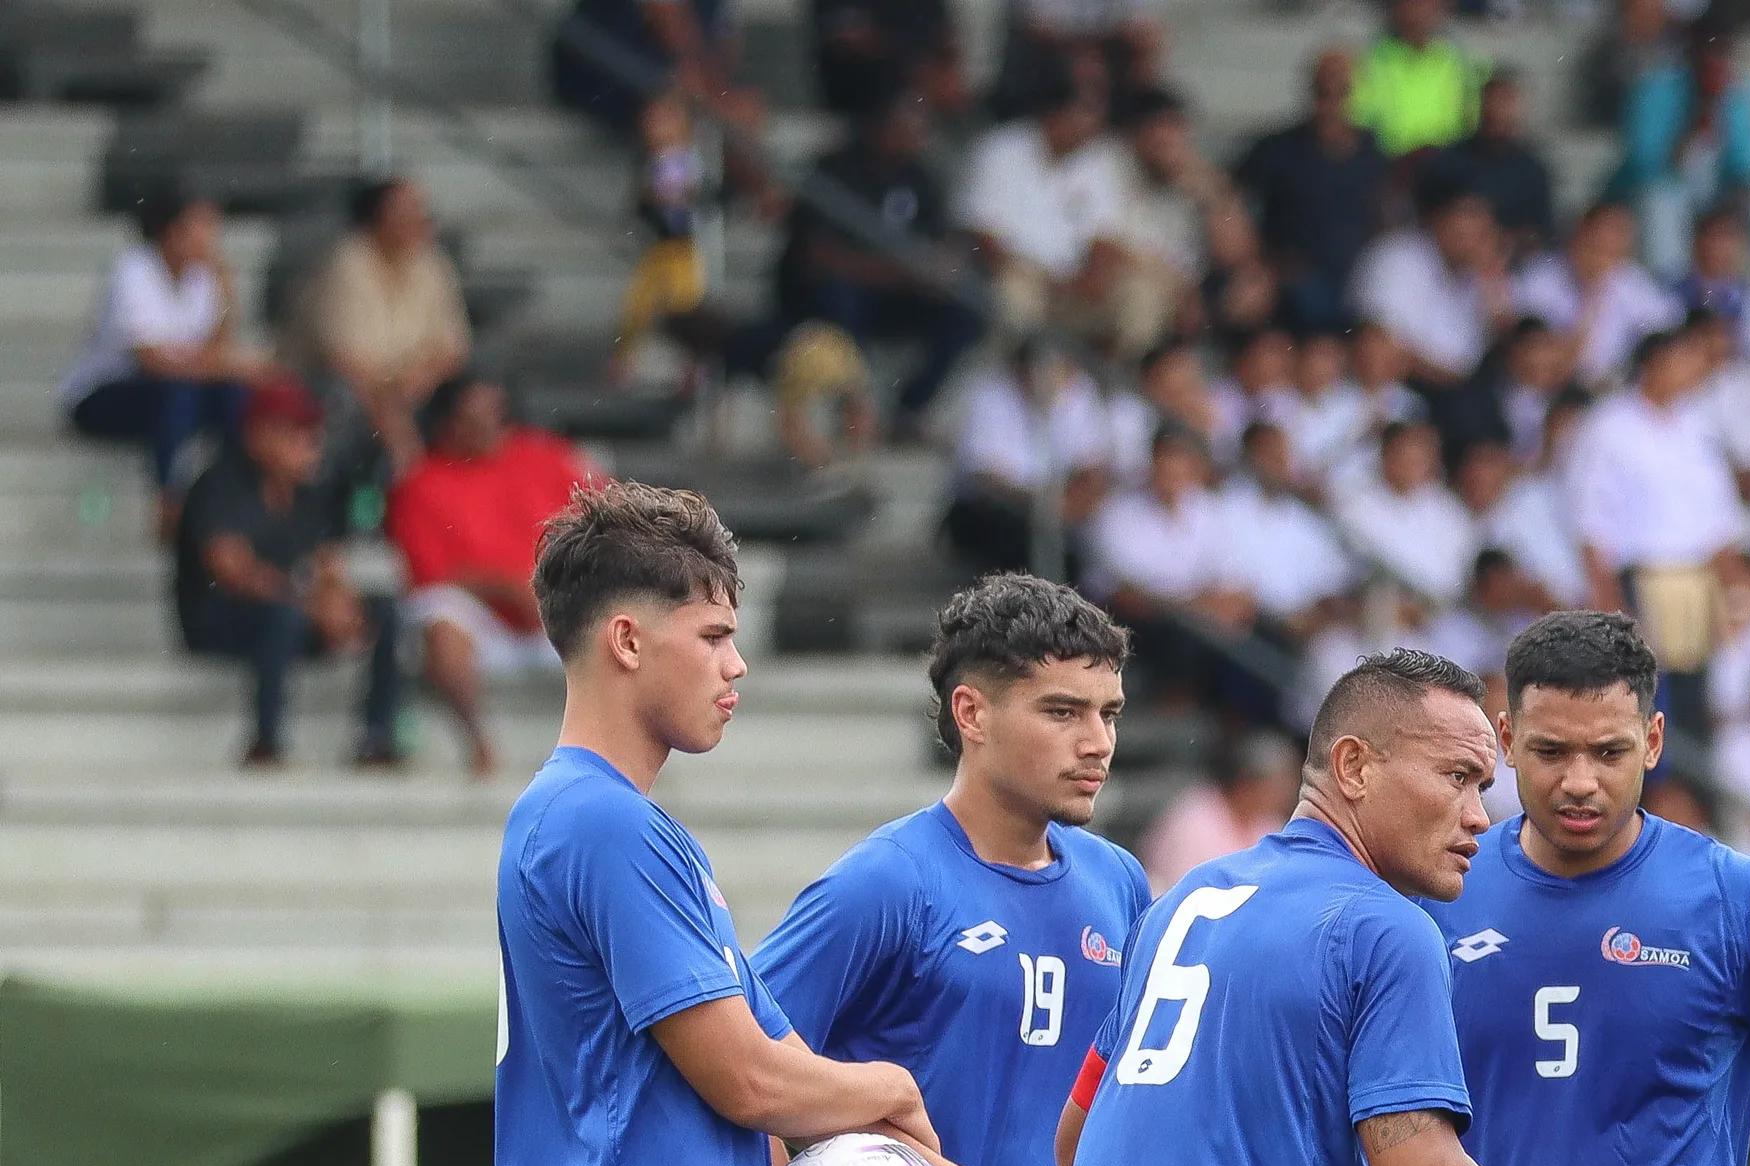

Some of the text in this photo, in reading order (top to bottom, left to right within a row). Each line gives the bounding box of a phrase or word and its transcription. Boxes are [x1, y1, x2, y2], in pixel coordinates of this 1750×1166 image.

[1019, 952, 1066, 1046] 19
[1116, 884, 1260, 1085] 6
[1640, 949, 1690, 966] SAMOA
[1534, 985, 1580, 1078] 5
